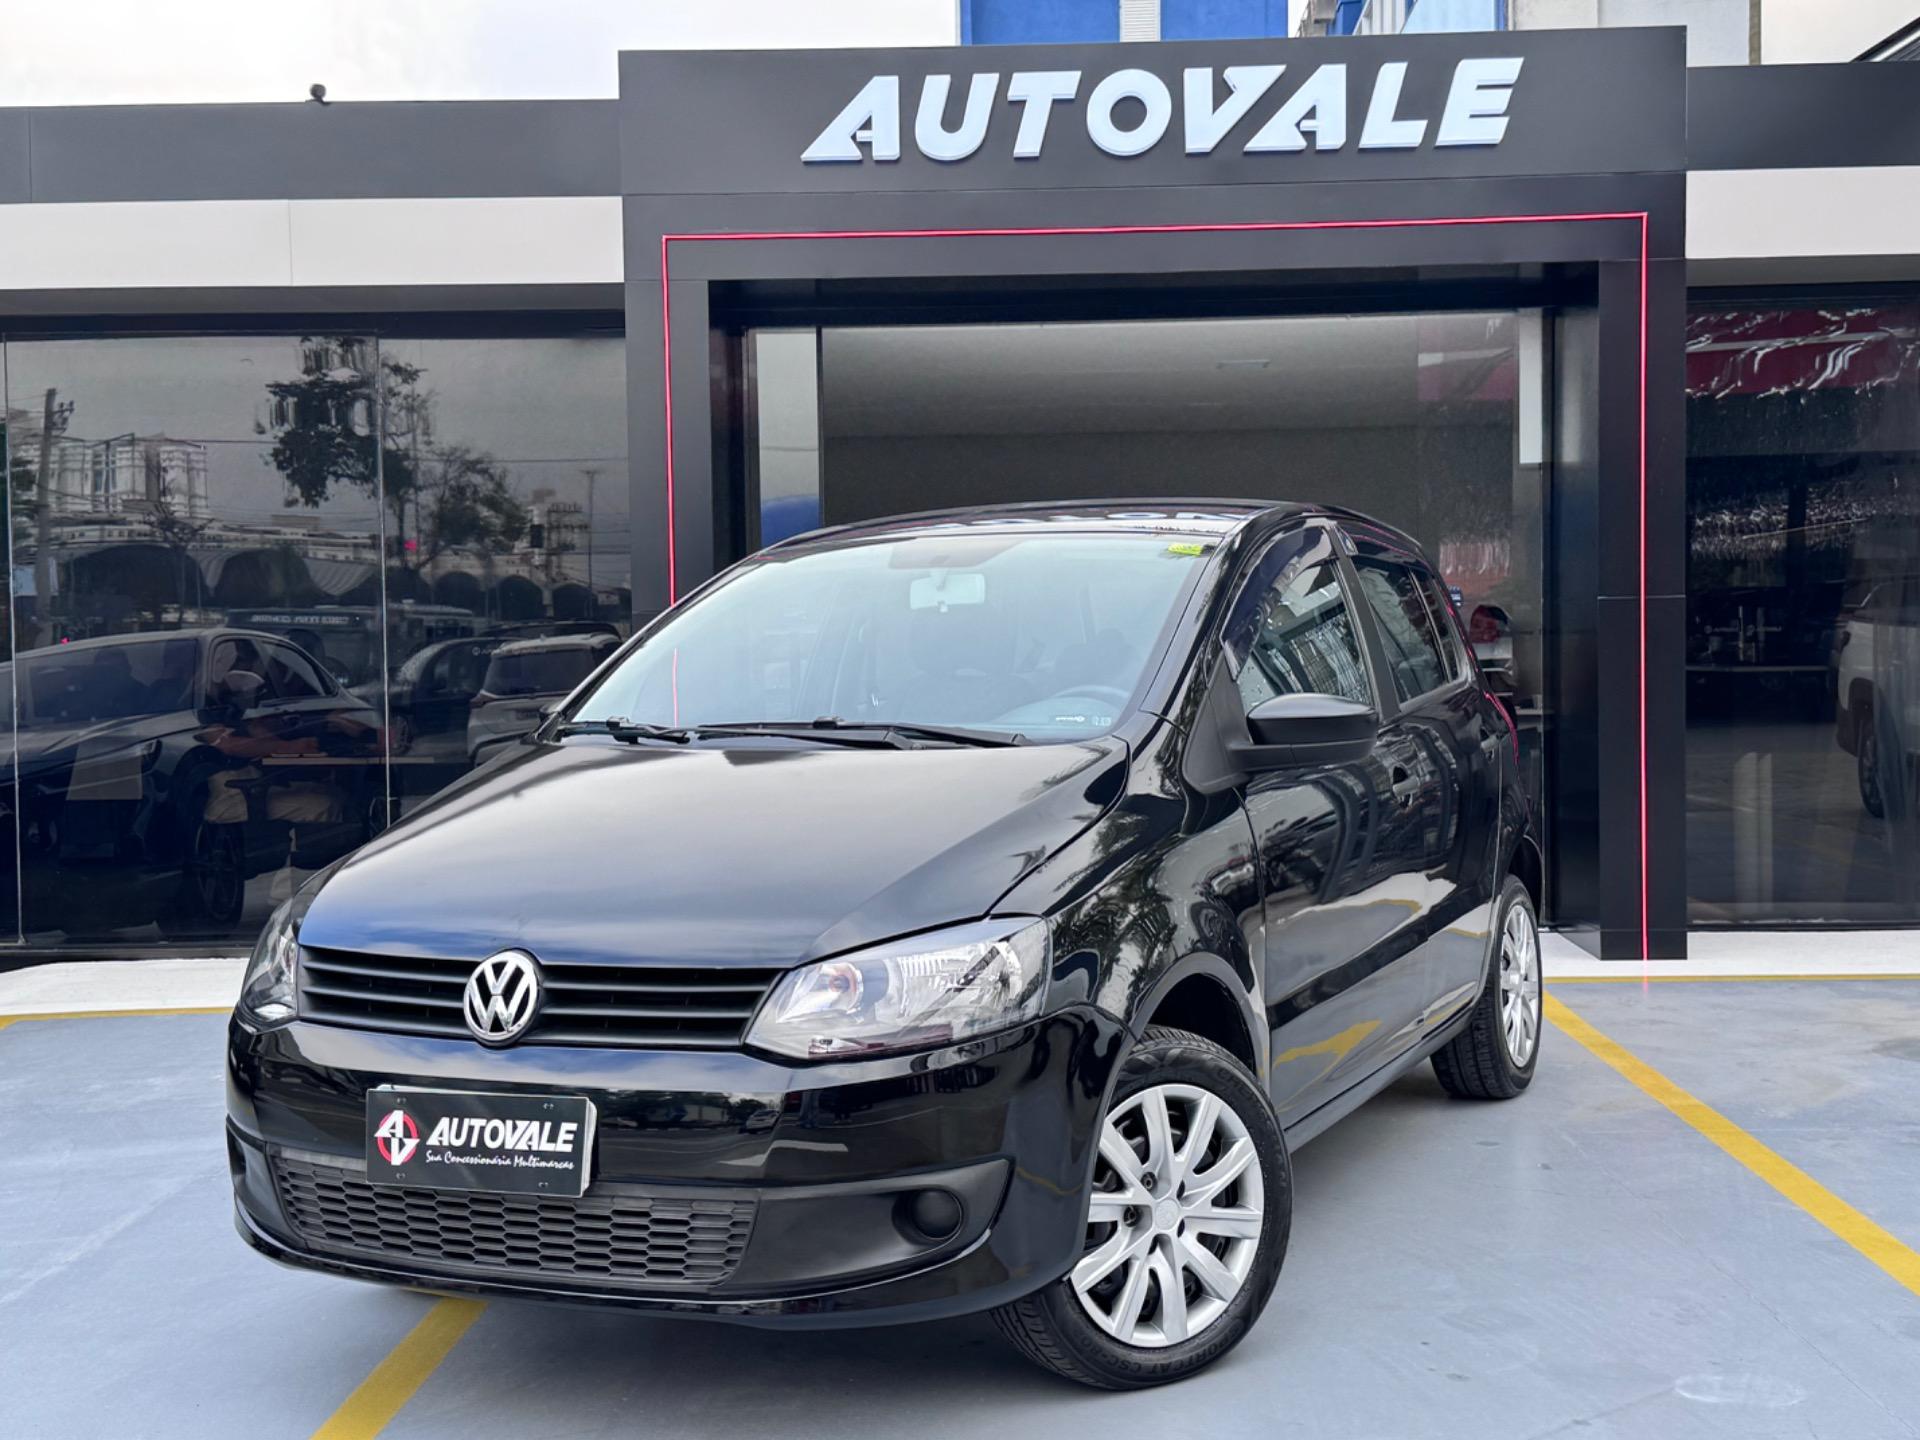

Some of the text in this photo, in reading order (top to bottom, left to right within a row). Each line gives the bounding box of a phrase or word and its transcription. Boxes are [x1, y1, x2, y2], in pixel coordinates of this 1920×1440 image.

[800, 56, 1525, 162] AUTOVALE
[425, 1116, 578, 1152] AUTOVALE
[425, 1150, 442, 1162] Sua
[513, 1154, 575, 1170] Multimarcas
